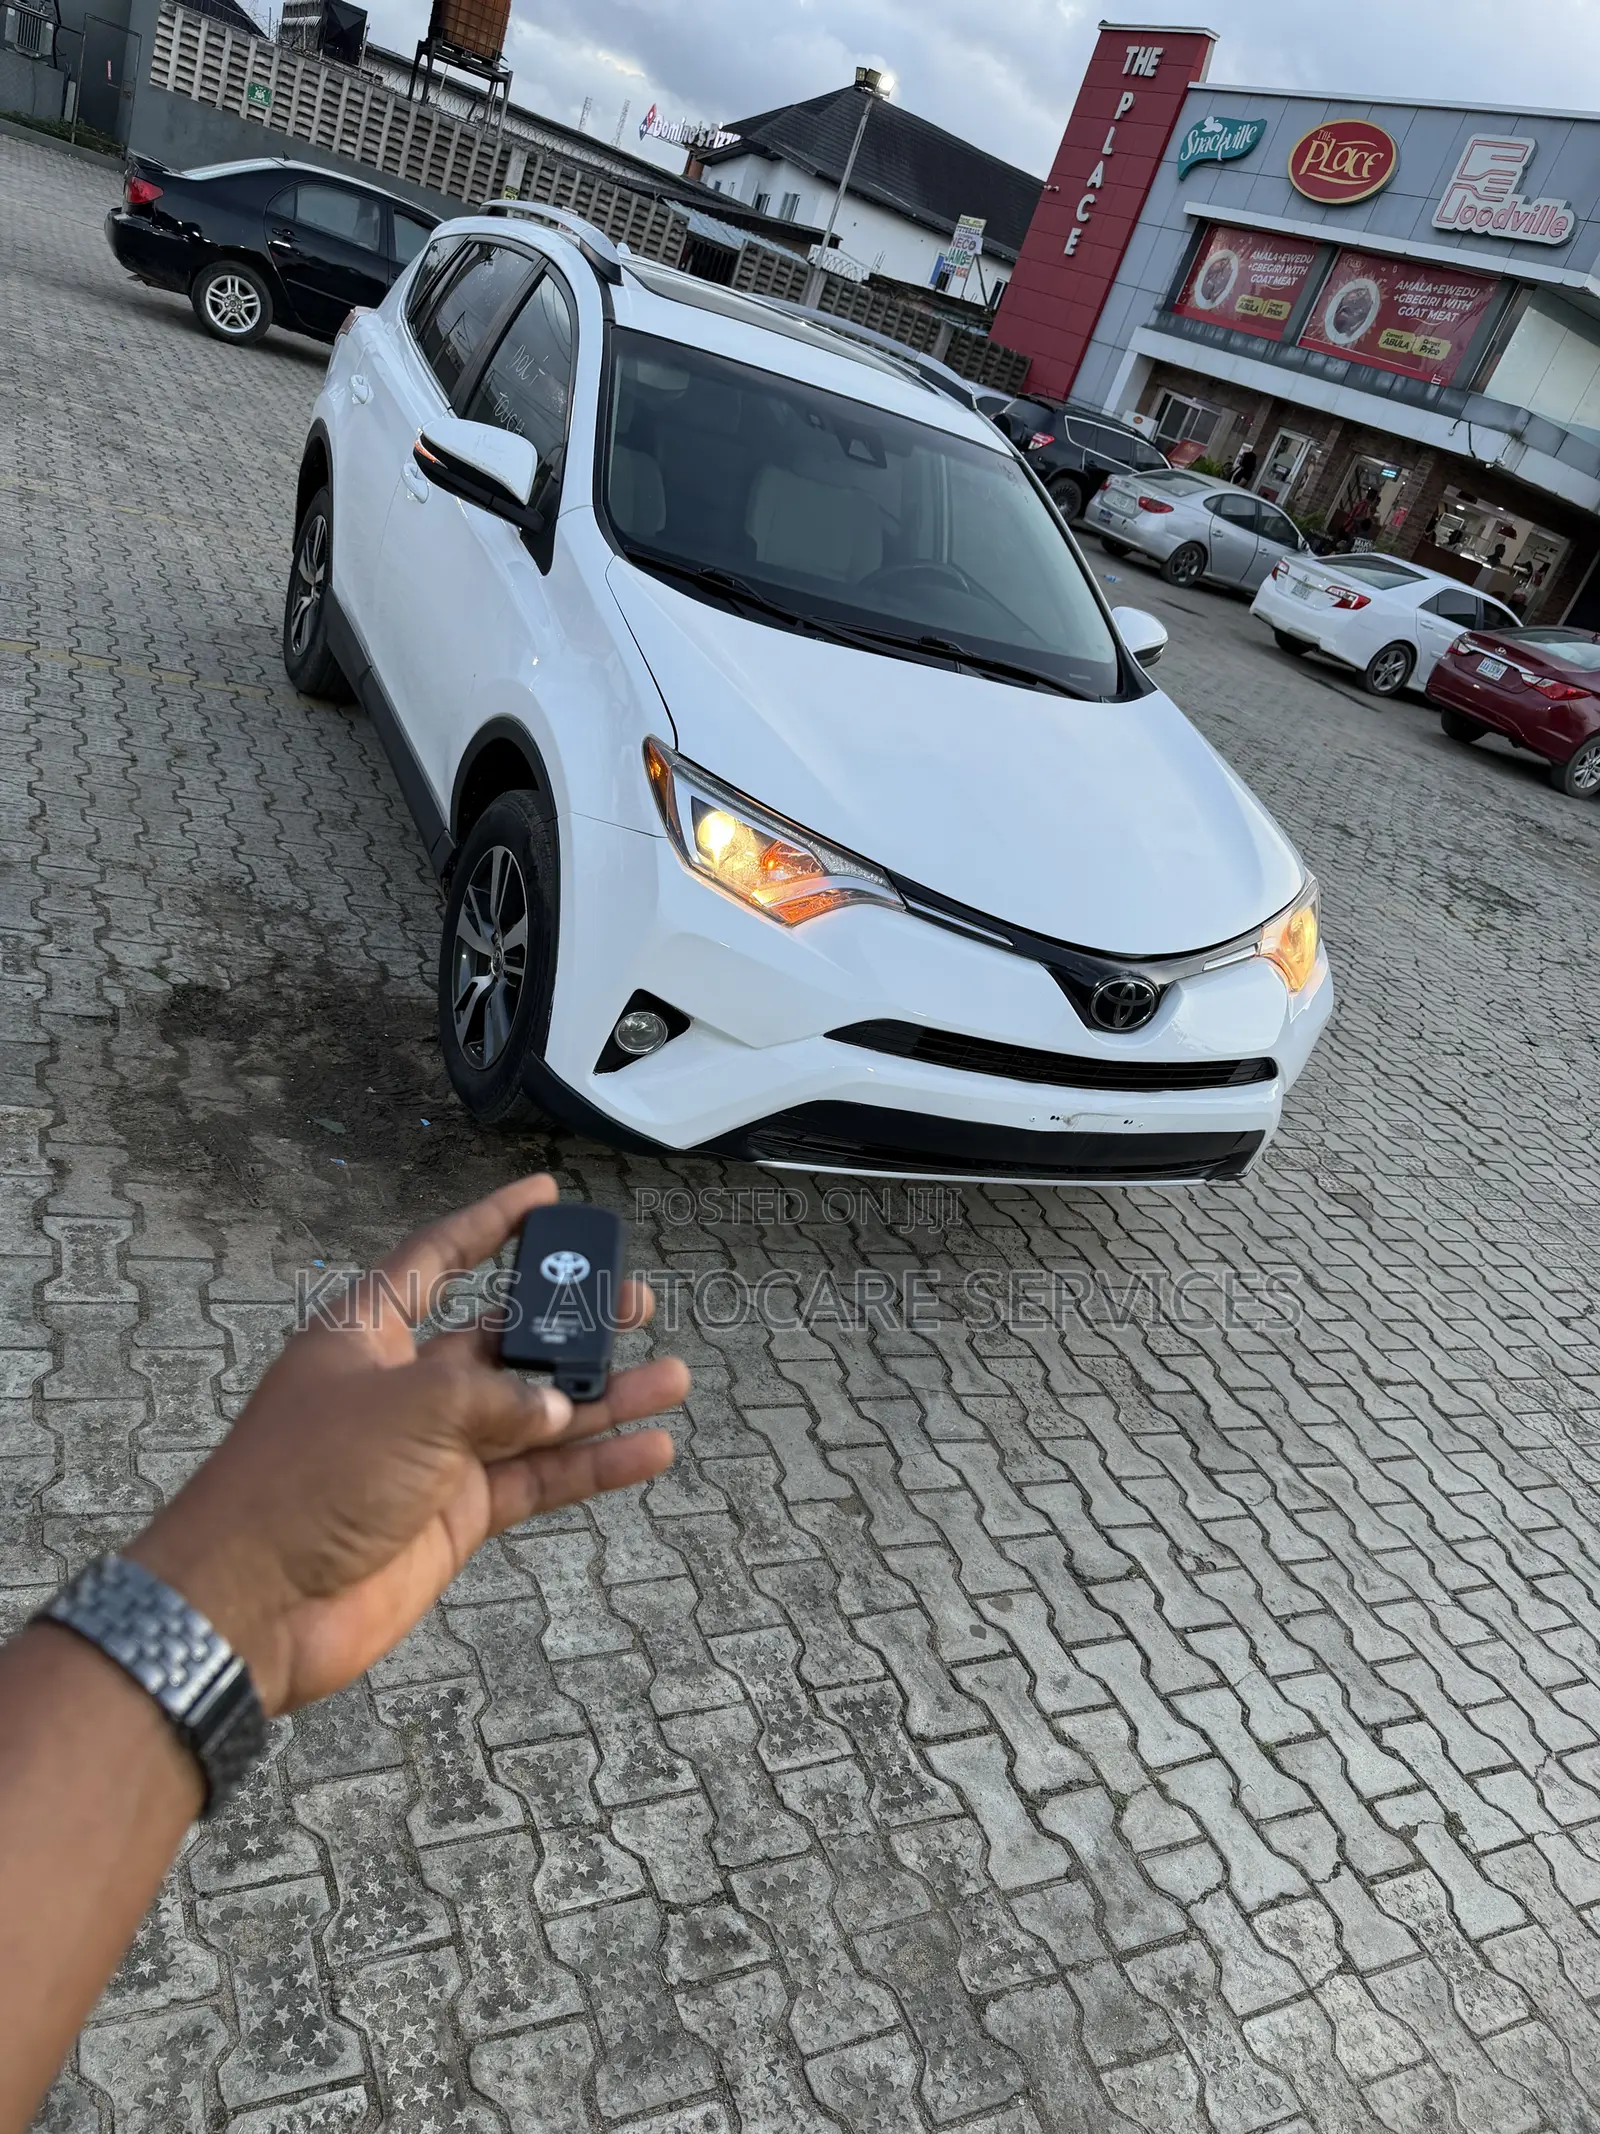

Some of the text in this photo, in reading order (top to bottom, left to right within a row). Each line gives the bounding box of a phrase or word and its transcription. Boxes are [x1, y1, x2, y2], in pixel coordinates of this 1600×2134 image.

[1122, 46, 1163, 77] THE
[654, 114, 706, 147] Domino's
[1317, 129, 1334, 141] THE
[1180, 124, 1258, 161] Snackville
[1064, 91, 1134, 256] PLACE
[1250, 250, 1315, 264] AMALA+EWEDU
[1248, 262, 1308, 276] +GBEGIRI WITH
[1250, 274, 1299, 287] GOAT MEAT
[1395, 280, 1481, 298] AMALA+EWEDU
[1393, 294, 1473, 311] +GBEGIRI WITH
[1266, 306, 1283, 317] Price
[1397, 306, 1460, 323] GOAT MEAT
[1382, 337, 1410, 350] ABULA
[1419, 344, 1441, 357] Price
